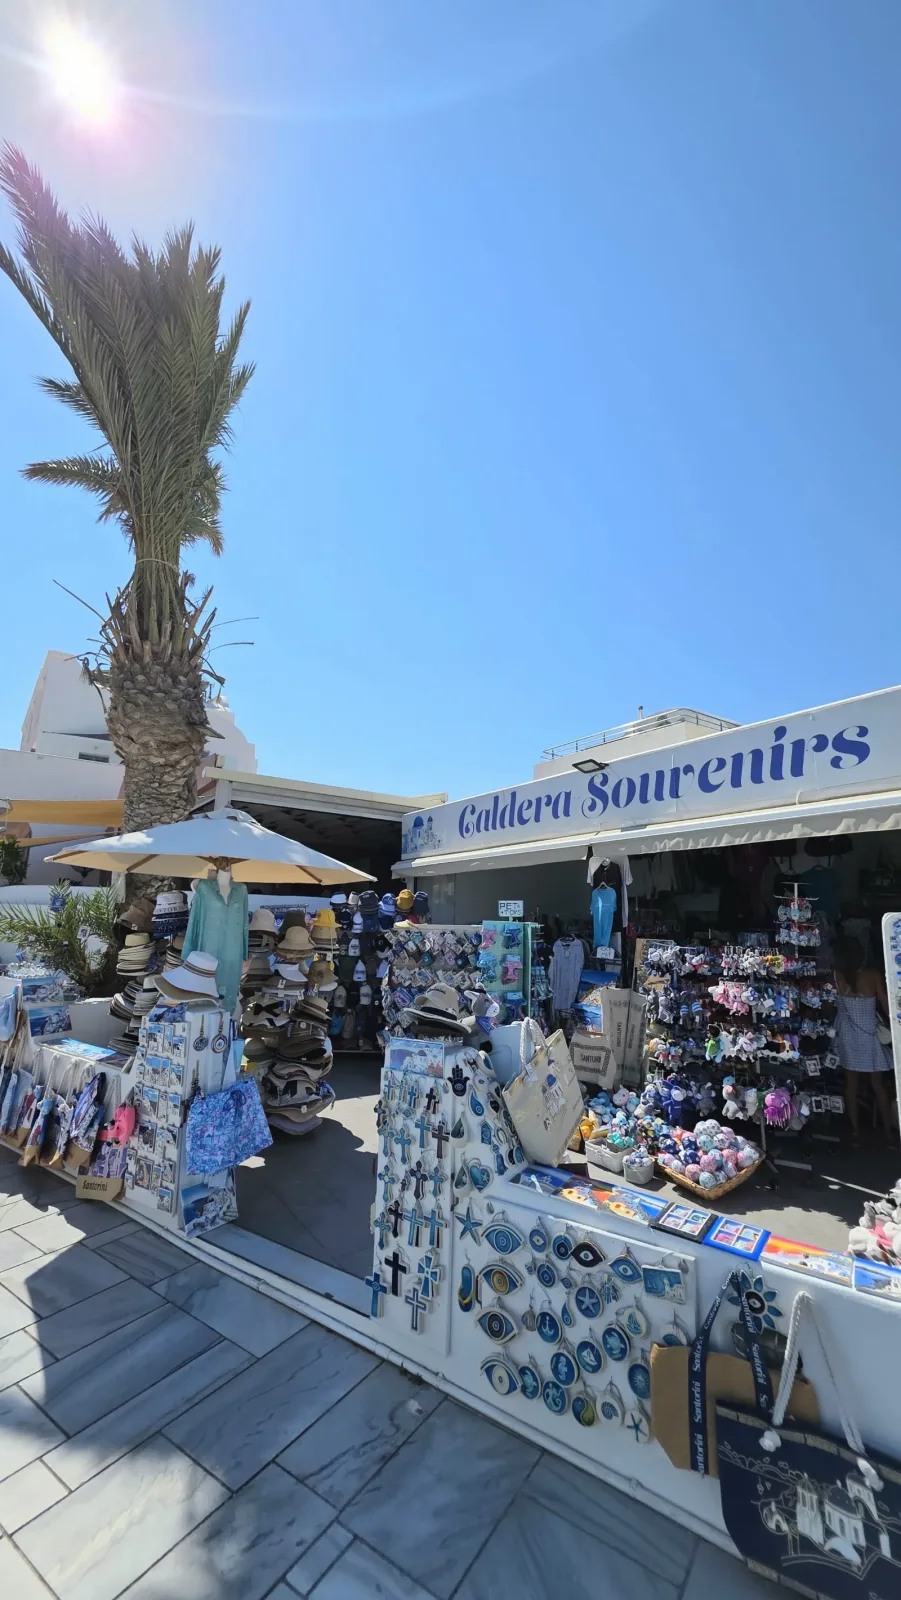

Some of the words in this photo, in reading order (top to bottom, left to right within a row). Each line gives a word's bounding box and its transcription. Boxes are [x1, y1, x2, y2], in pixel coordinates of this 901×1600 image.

[458, 790, 572, 840] Caldera
[581, 725, 871, 819] Souvenirs
[499, 902, 518, 910] PET
[82, 1180, 108, 1191] Santorini
